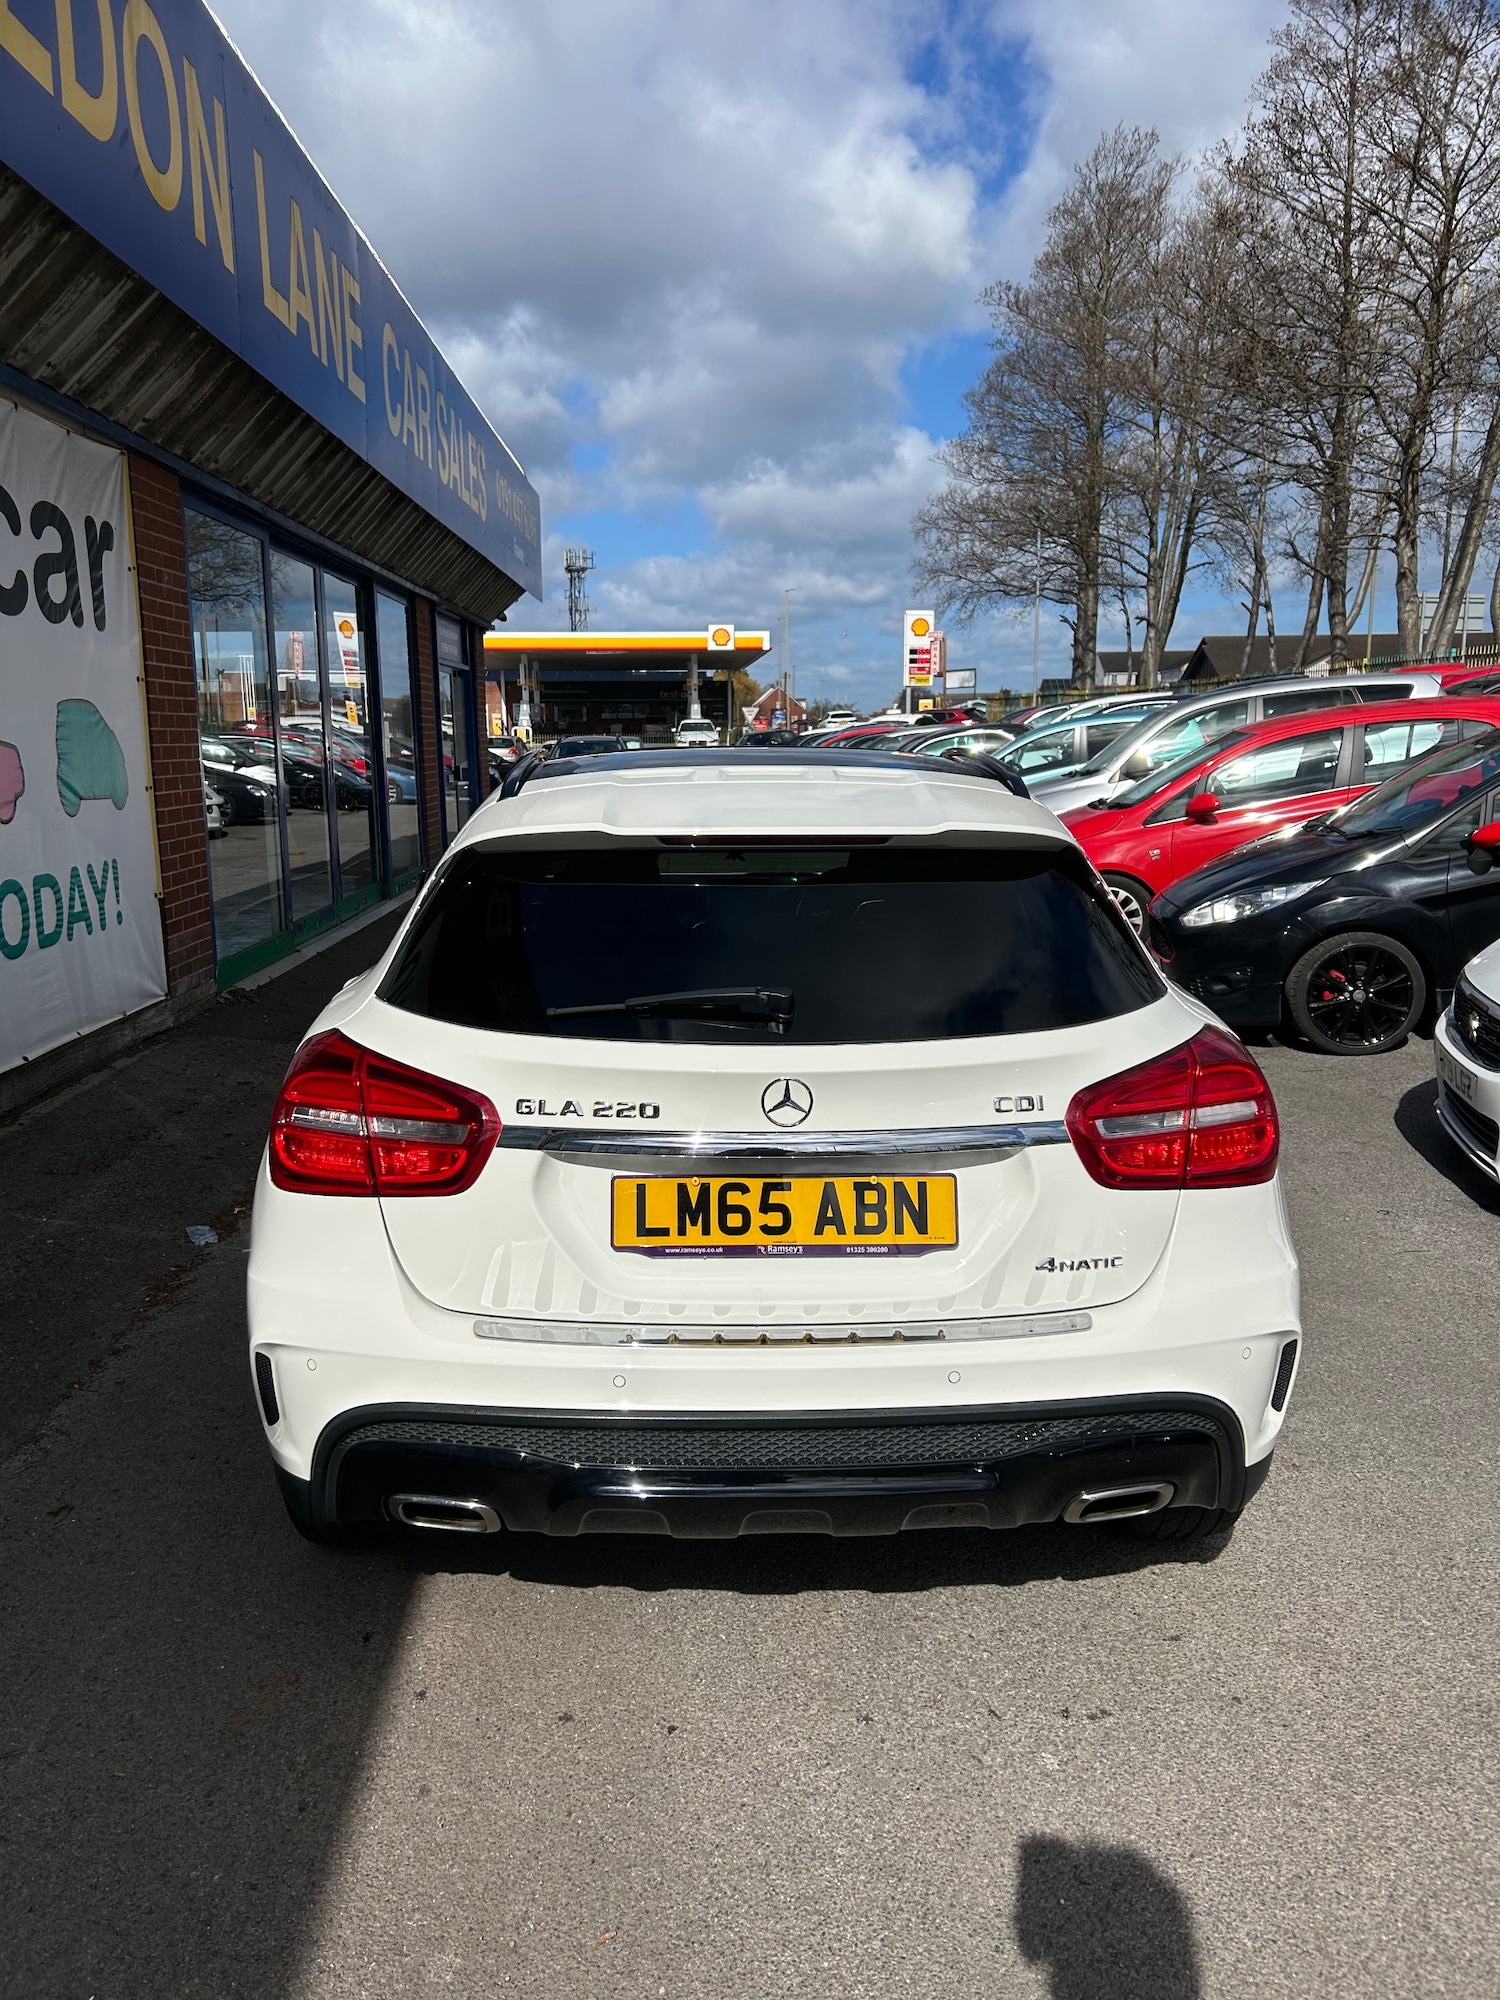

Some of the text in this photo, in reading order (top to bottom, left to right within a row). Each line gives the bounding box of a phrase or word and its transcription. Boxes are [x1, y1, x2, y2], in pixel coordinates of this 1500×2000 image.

[253, 147, 367, 405] LANE
[382, 321, 433, 470] CAR
[437, 388, 488, 522] SALES
[516, 1098, 661, 1119] GLA 220
[993, 1095, 1044, 1113] CDI
[636, 1181, 929, 1238] LM65 ABN
[846, 1246, 865, 1254] 01325
[1034, 1256, 1123, 1273] 4MATIC
